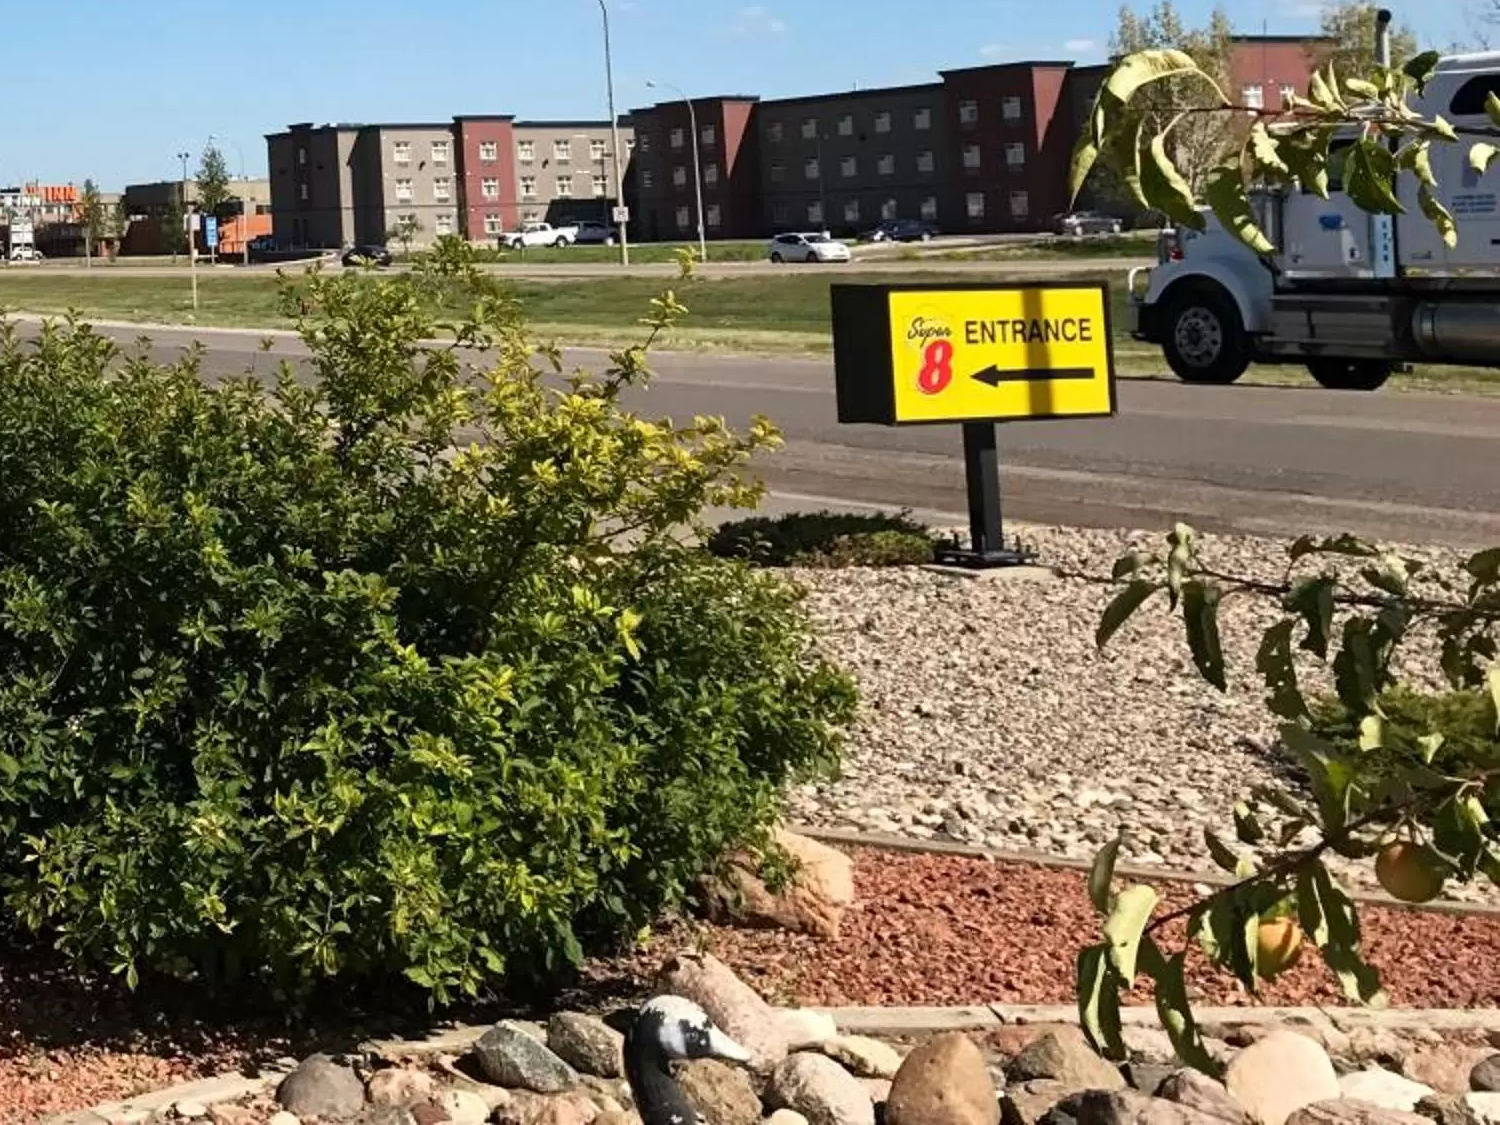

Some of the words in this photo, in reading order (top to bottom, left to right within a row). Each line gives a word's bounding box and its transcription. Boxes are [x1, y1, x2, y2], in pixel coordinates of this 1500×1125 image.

[907, 316, 952, 348] Super
[964, 318, 1093, 344] ENTRANCE
[918, 338, 954, 395] 8
